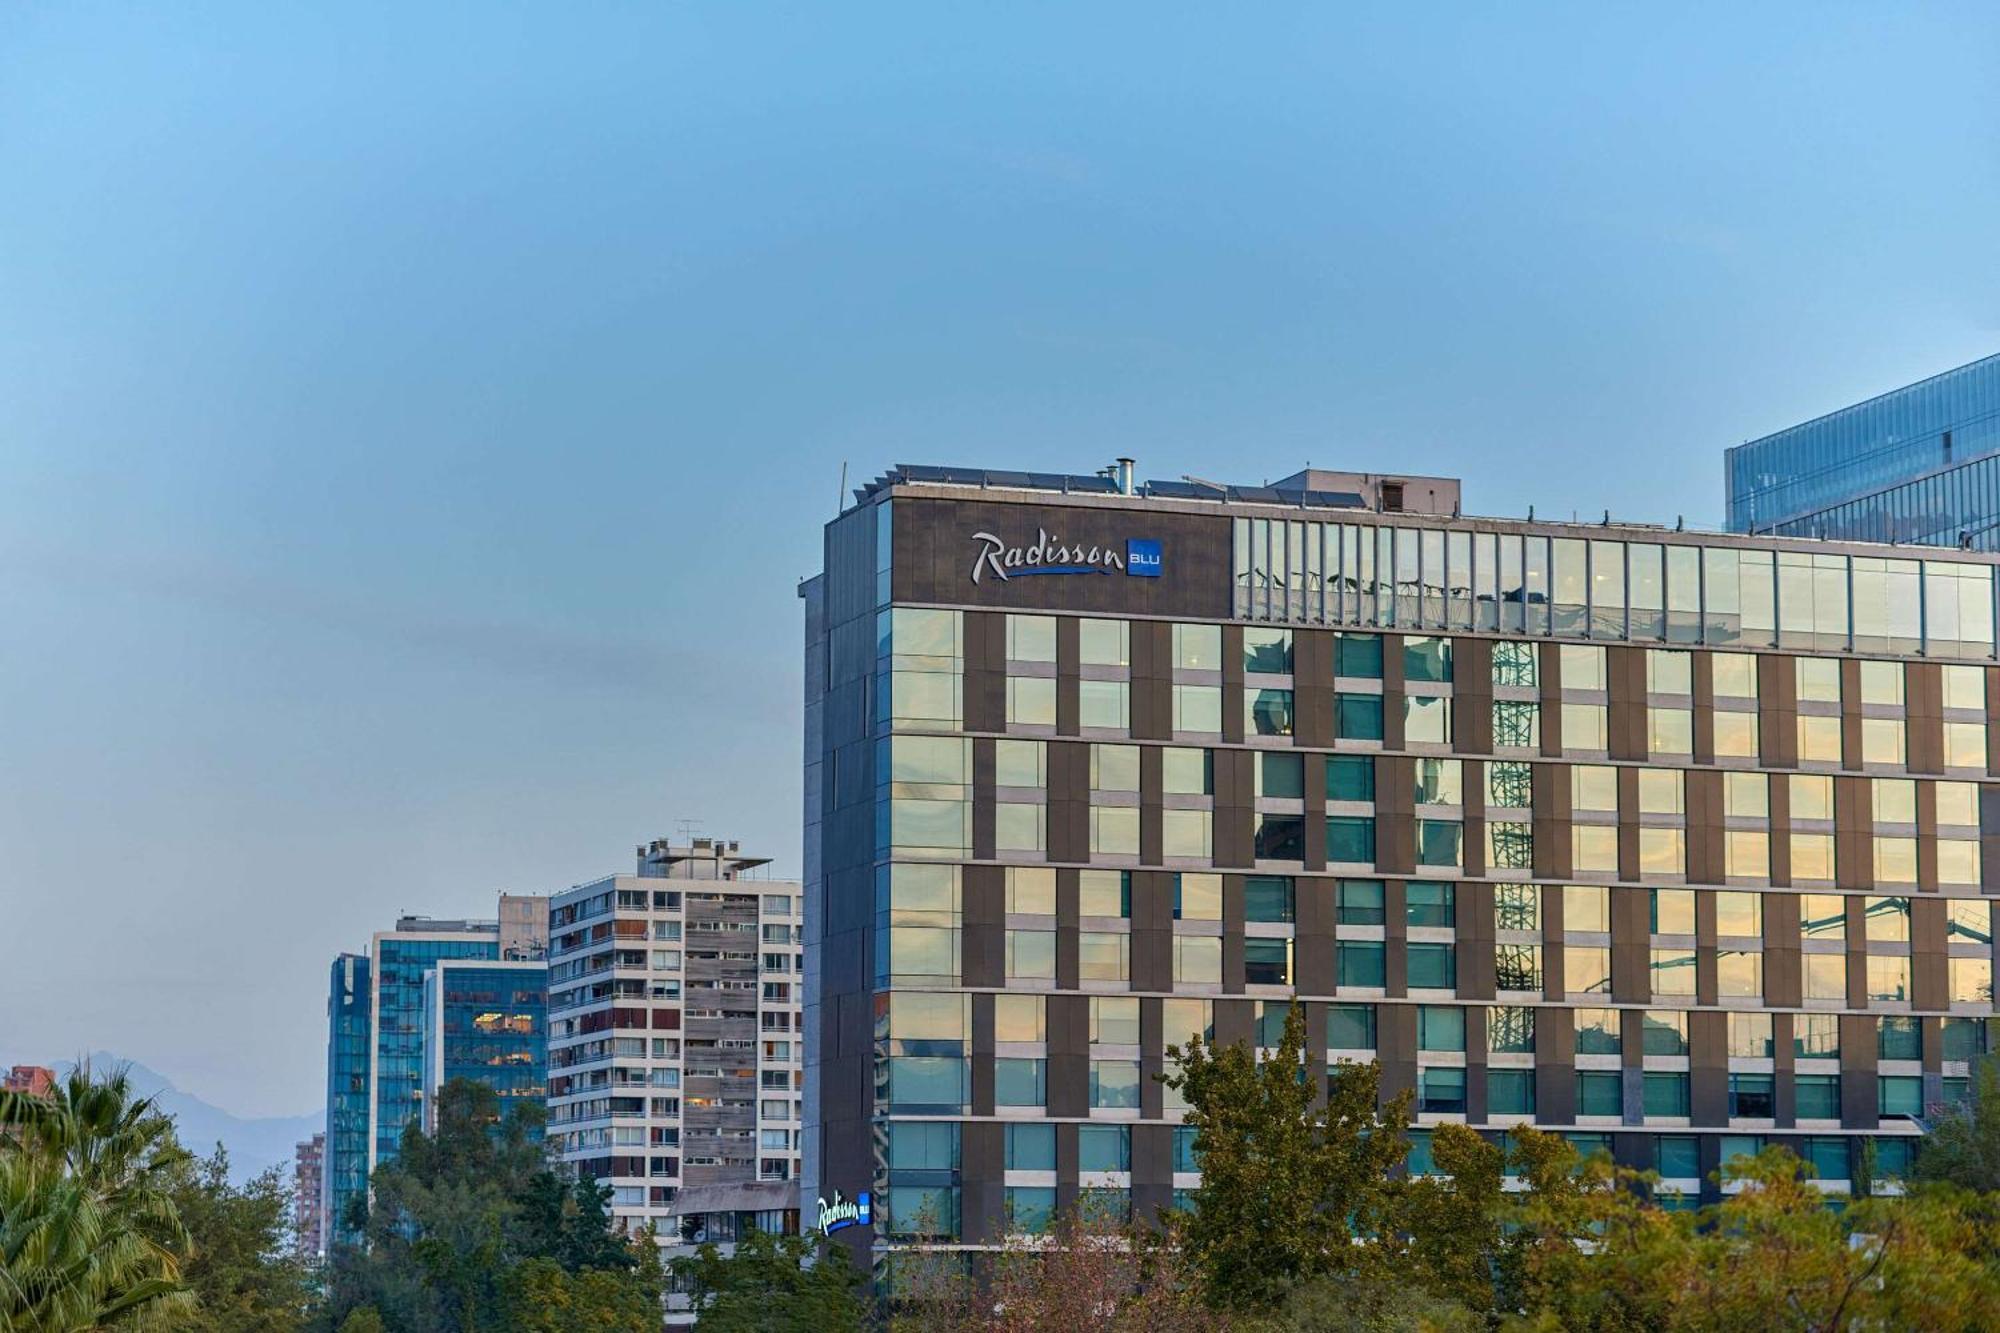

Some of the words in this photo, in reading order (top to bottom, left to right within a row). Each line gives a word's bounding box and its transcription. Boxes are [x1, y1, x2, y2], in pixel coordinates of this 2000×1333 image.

[972, 527, 1124, 585] Radisson
[1129, 553, 1160, 565] BLU
[817, 1190, 859, 1237] Radisson
